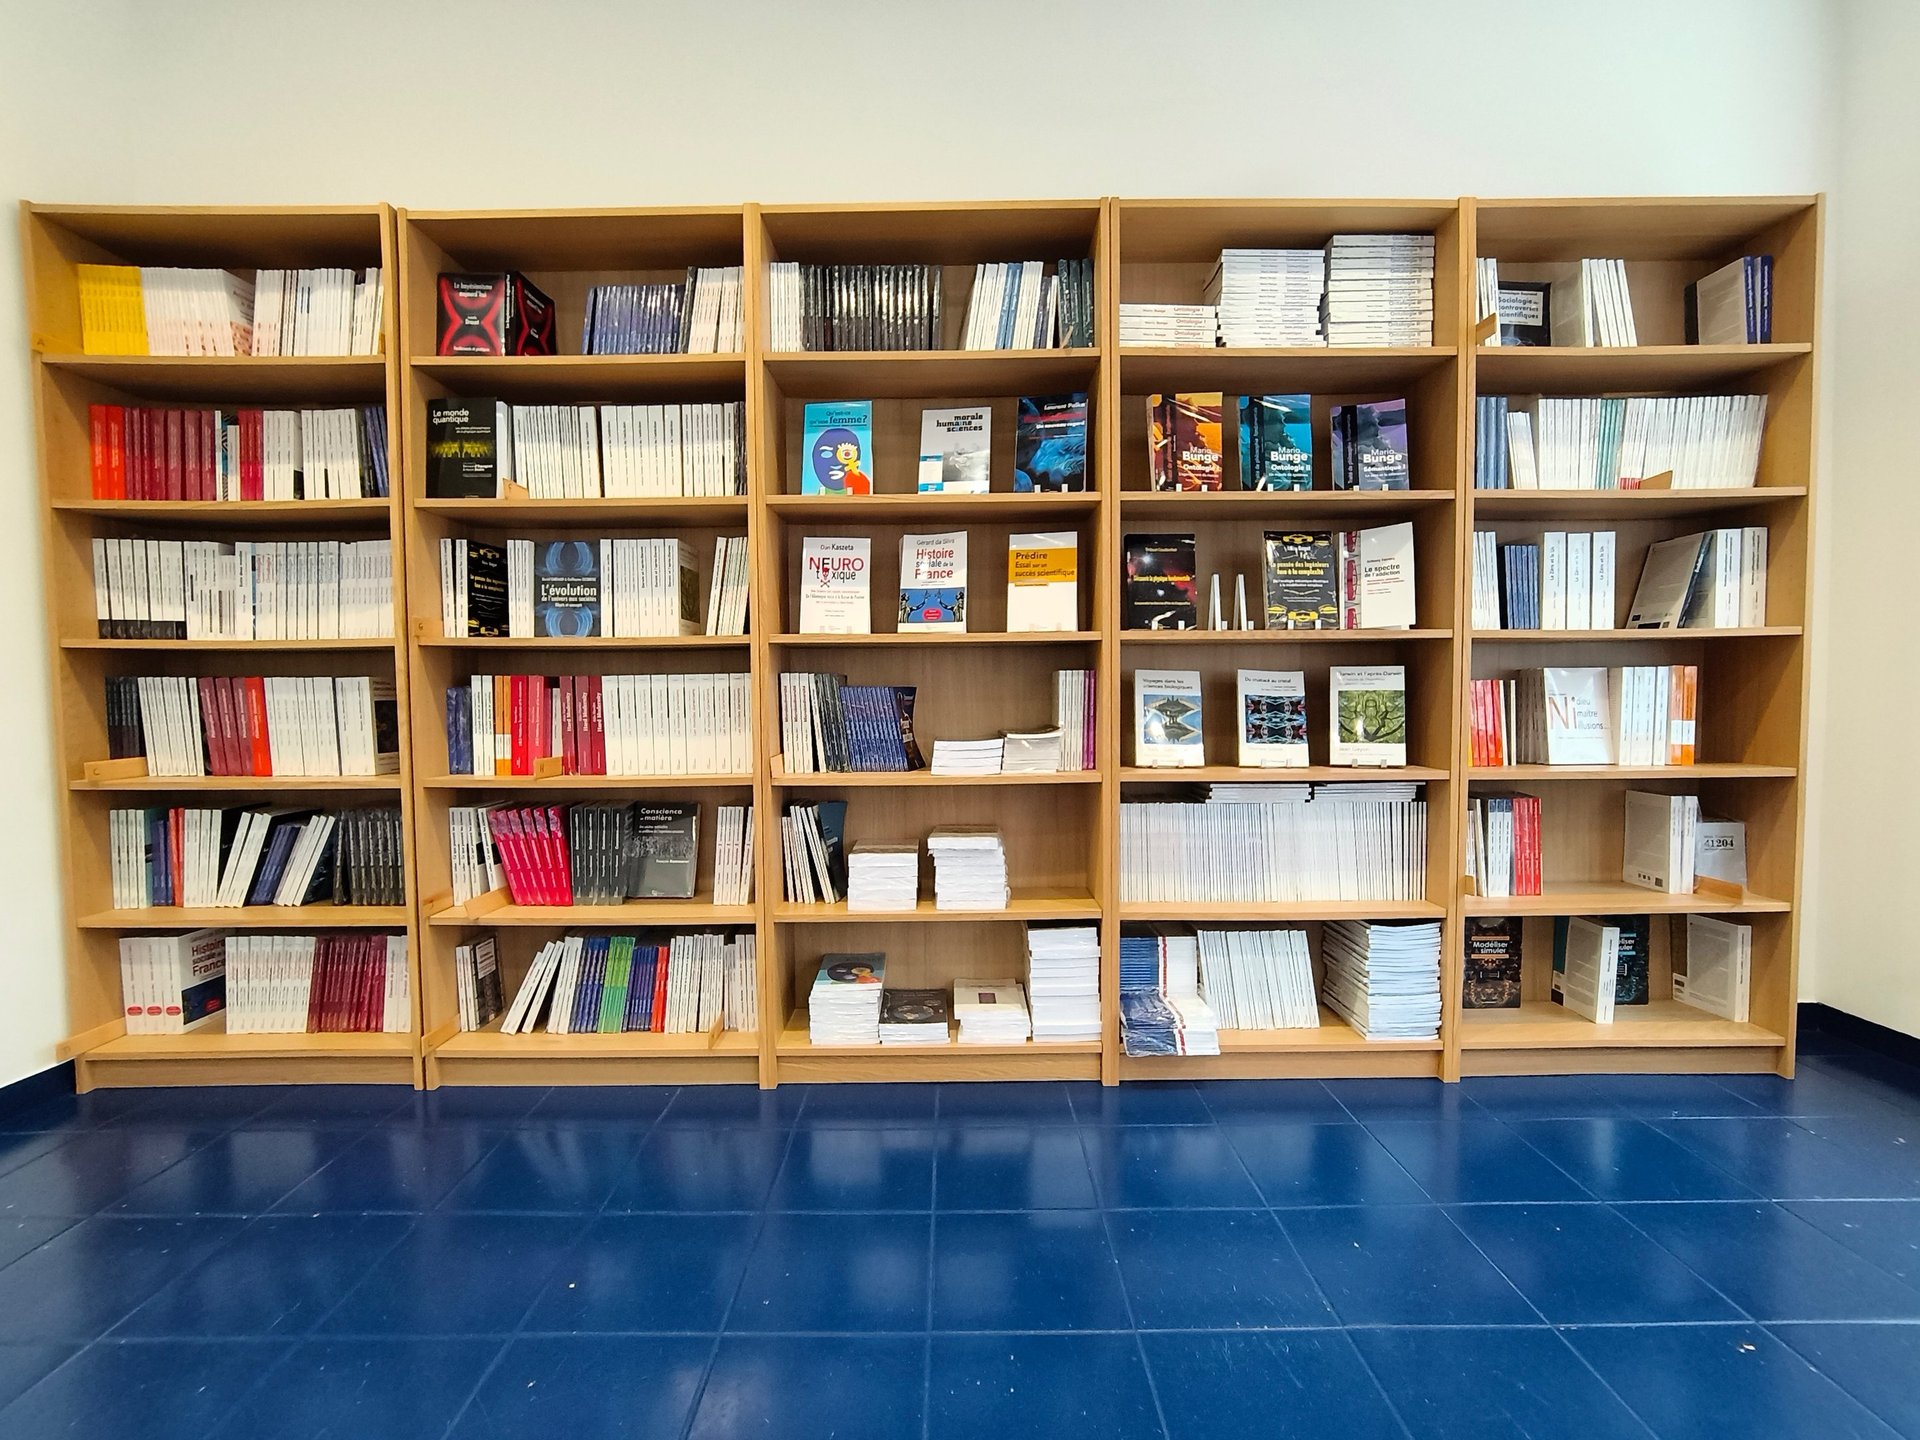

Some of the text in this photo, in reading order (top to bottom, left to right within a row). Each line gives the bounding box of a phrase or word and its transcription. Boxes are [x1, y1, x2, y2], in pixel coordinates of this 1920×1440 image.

[433, 417, 469, 425] quantique
[830, 415, 867, 423] femme?
[1182, 451, 1218, 463] Bunge
[1271, 451, 1308, 463] Bunge
[1364, 454, 1402, 464] Bunge
[1271, 464, 1304, 472] Ontologie
[917, 548, 954, 559] Histoire
[809, 557, 864, 571] NEURO
[1374, 564, 1400, 573] spectre
[816, 569, 856, 583] txique
[915, 569, 953, 579] Fance
[1037, 569, 1074, 577] scientifique
[542, 583, 596, 596] L'évolution
[1549, 697, 1576, 729] Ni
[1704, 839, 1734, 847] 41204
